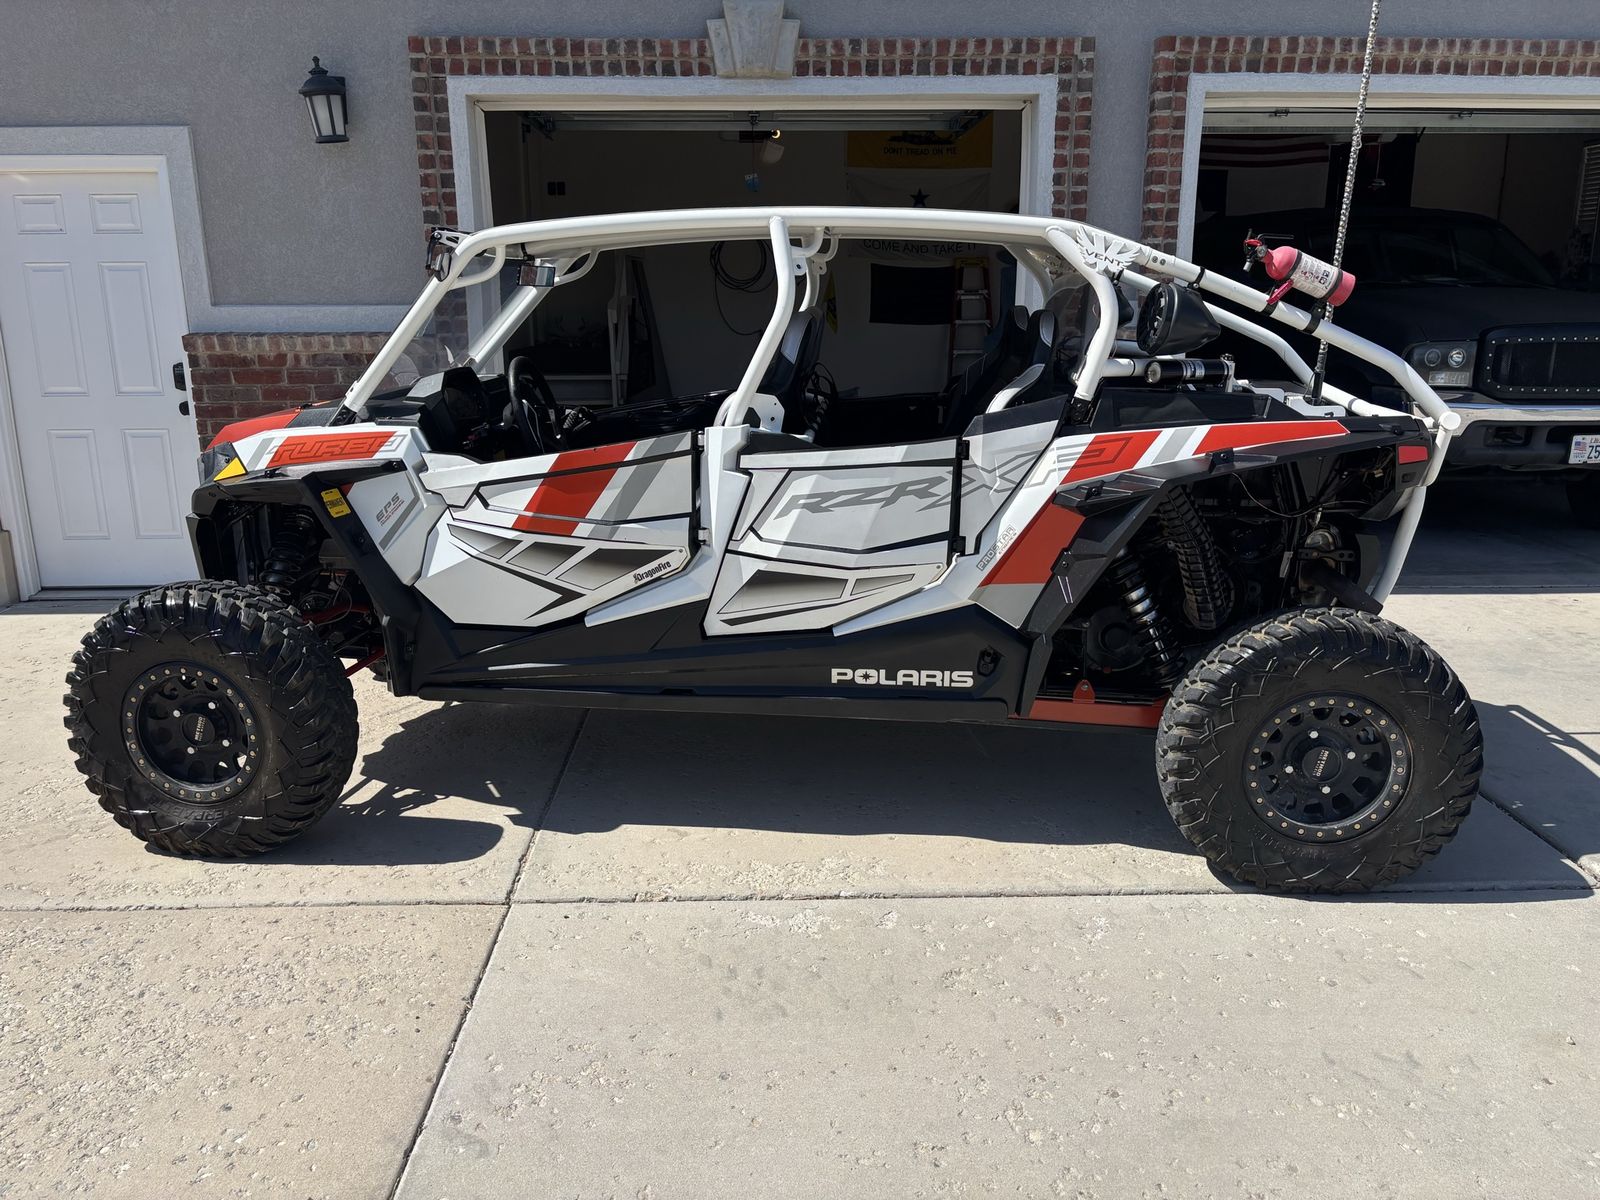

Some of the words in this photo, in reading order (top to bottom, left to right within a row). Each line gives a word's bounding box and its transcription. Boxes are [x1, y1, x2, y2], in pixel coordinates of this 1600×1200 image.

[863, 239, 900, 252] COME
[902, 243, 929, 254] AND
[931, 242, 962, 254] TAKE
[1085, 248, 1124, 267] VENT
[266, 433, 407, 463] TURBO
[376, 492, 400, 522] EPS
[774, 475, 948, 520] RZR
[636, 560, 672, 582] DragonFire
[831, 668, 974, 688] POLARIS
